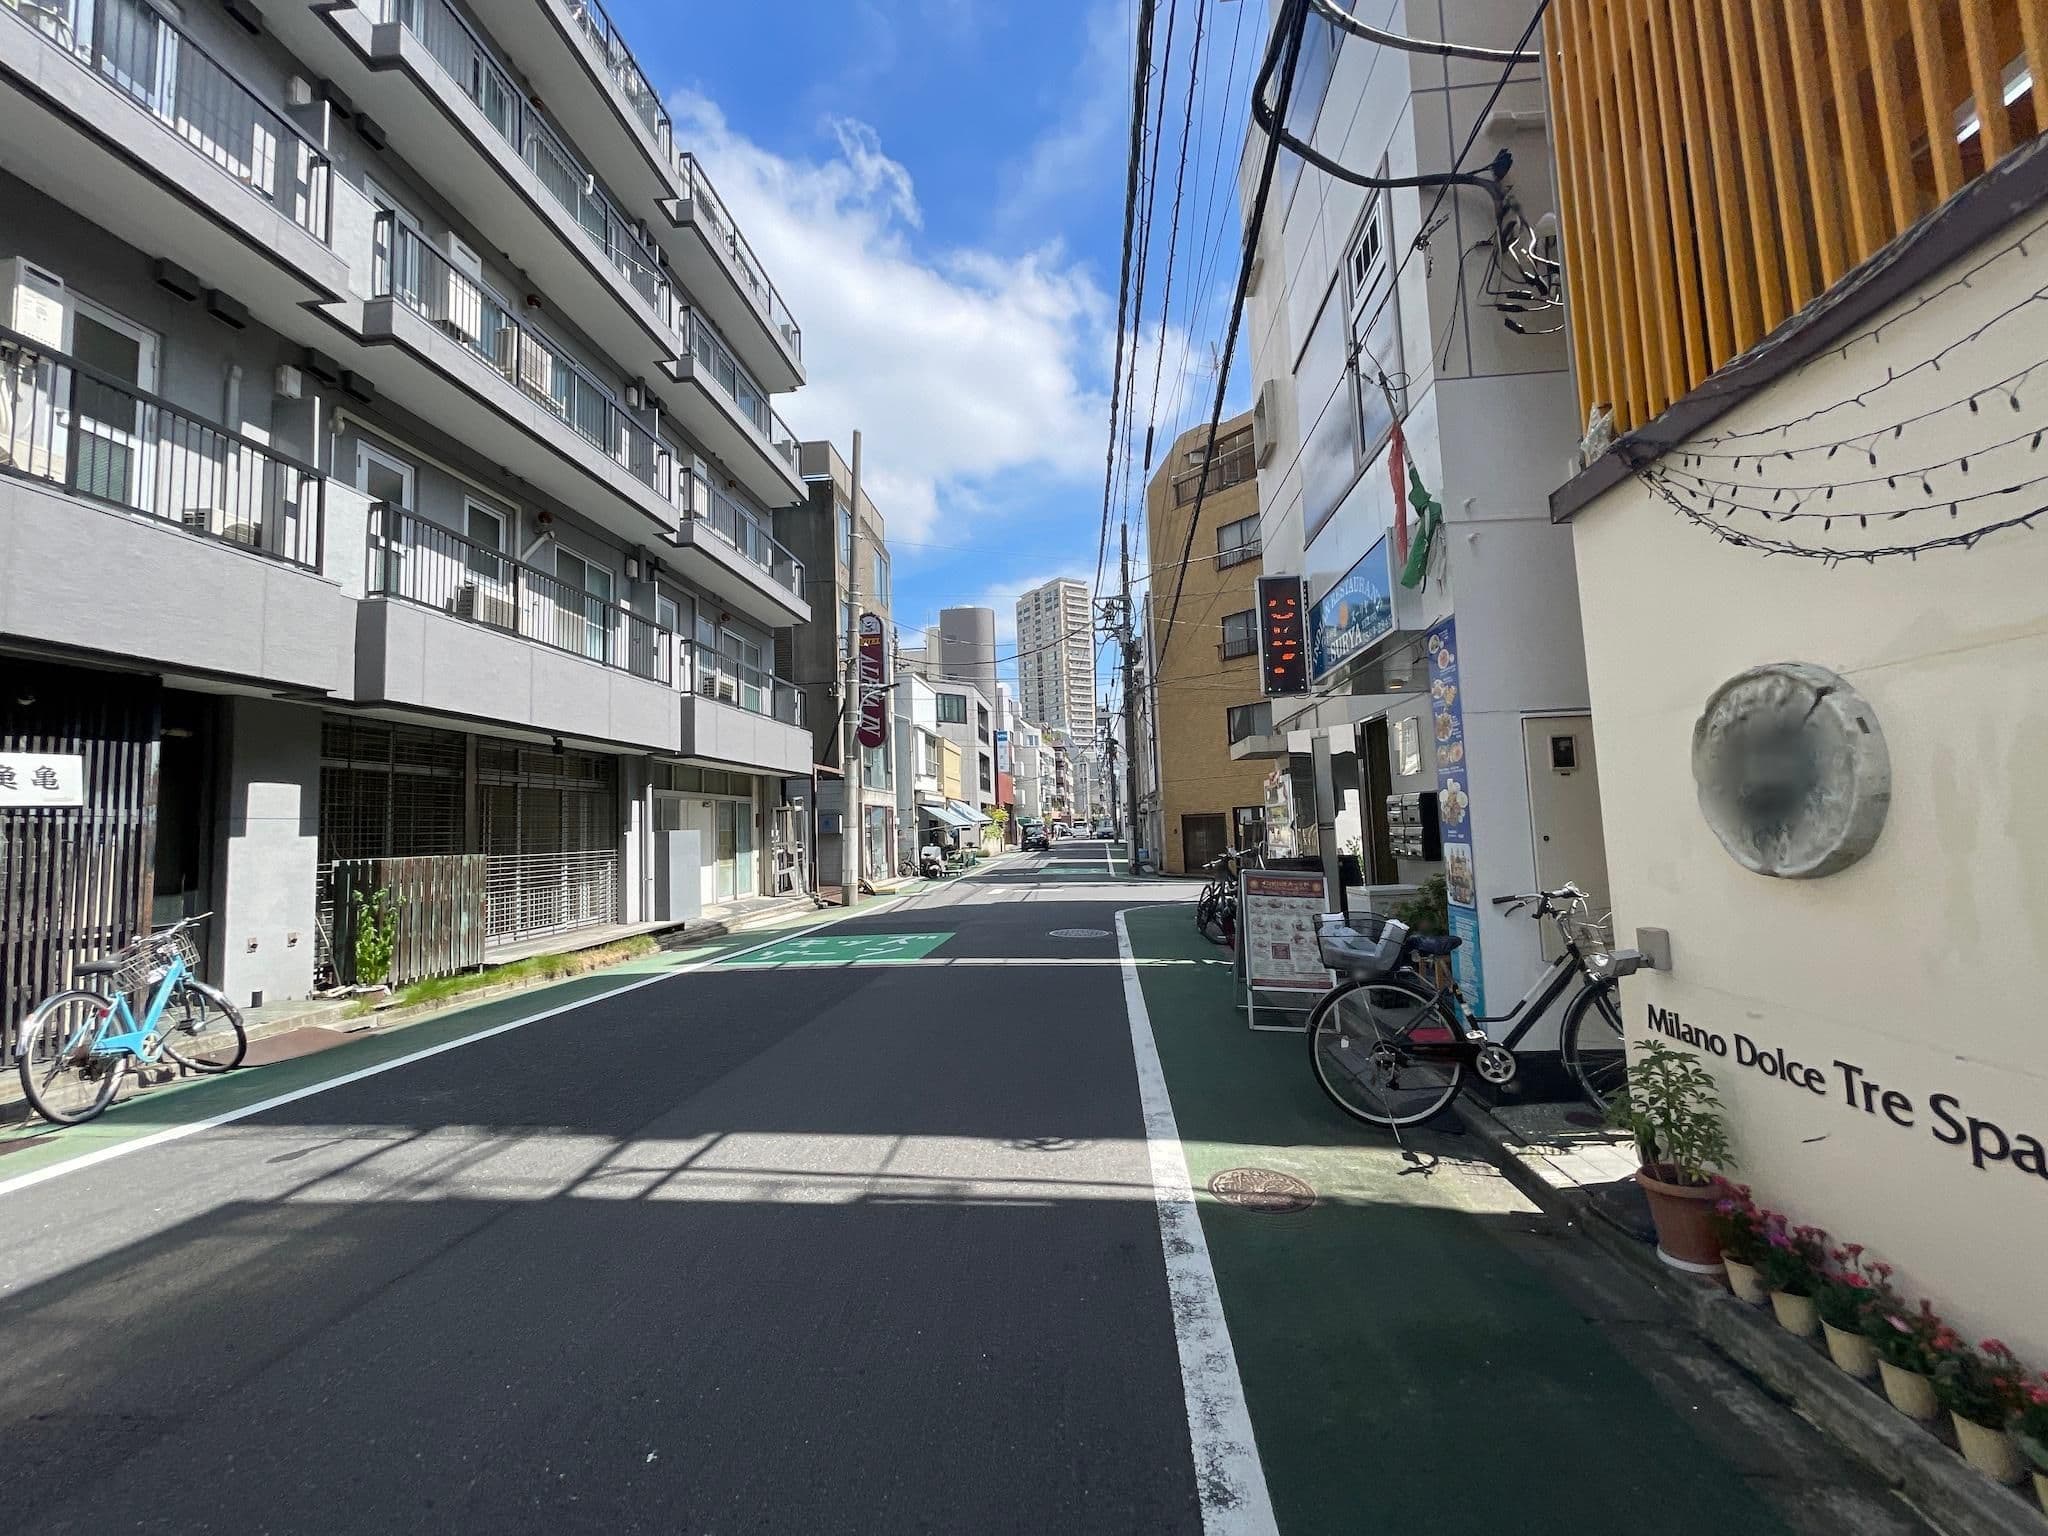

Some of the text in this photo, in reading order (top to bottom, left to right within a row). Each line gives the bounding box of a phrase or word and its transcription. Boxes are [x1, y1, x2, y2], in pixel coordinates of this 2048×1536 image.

[1330, 622, 1362, 662] SURYA
[861, 713, 881, 738] IN
[1647, 1003, 1727, 1057] Milano
[1733, 1033, 1826, 1095] Dolce
[1833, 1059, 1914, 1127] Tre
